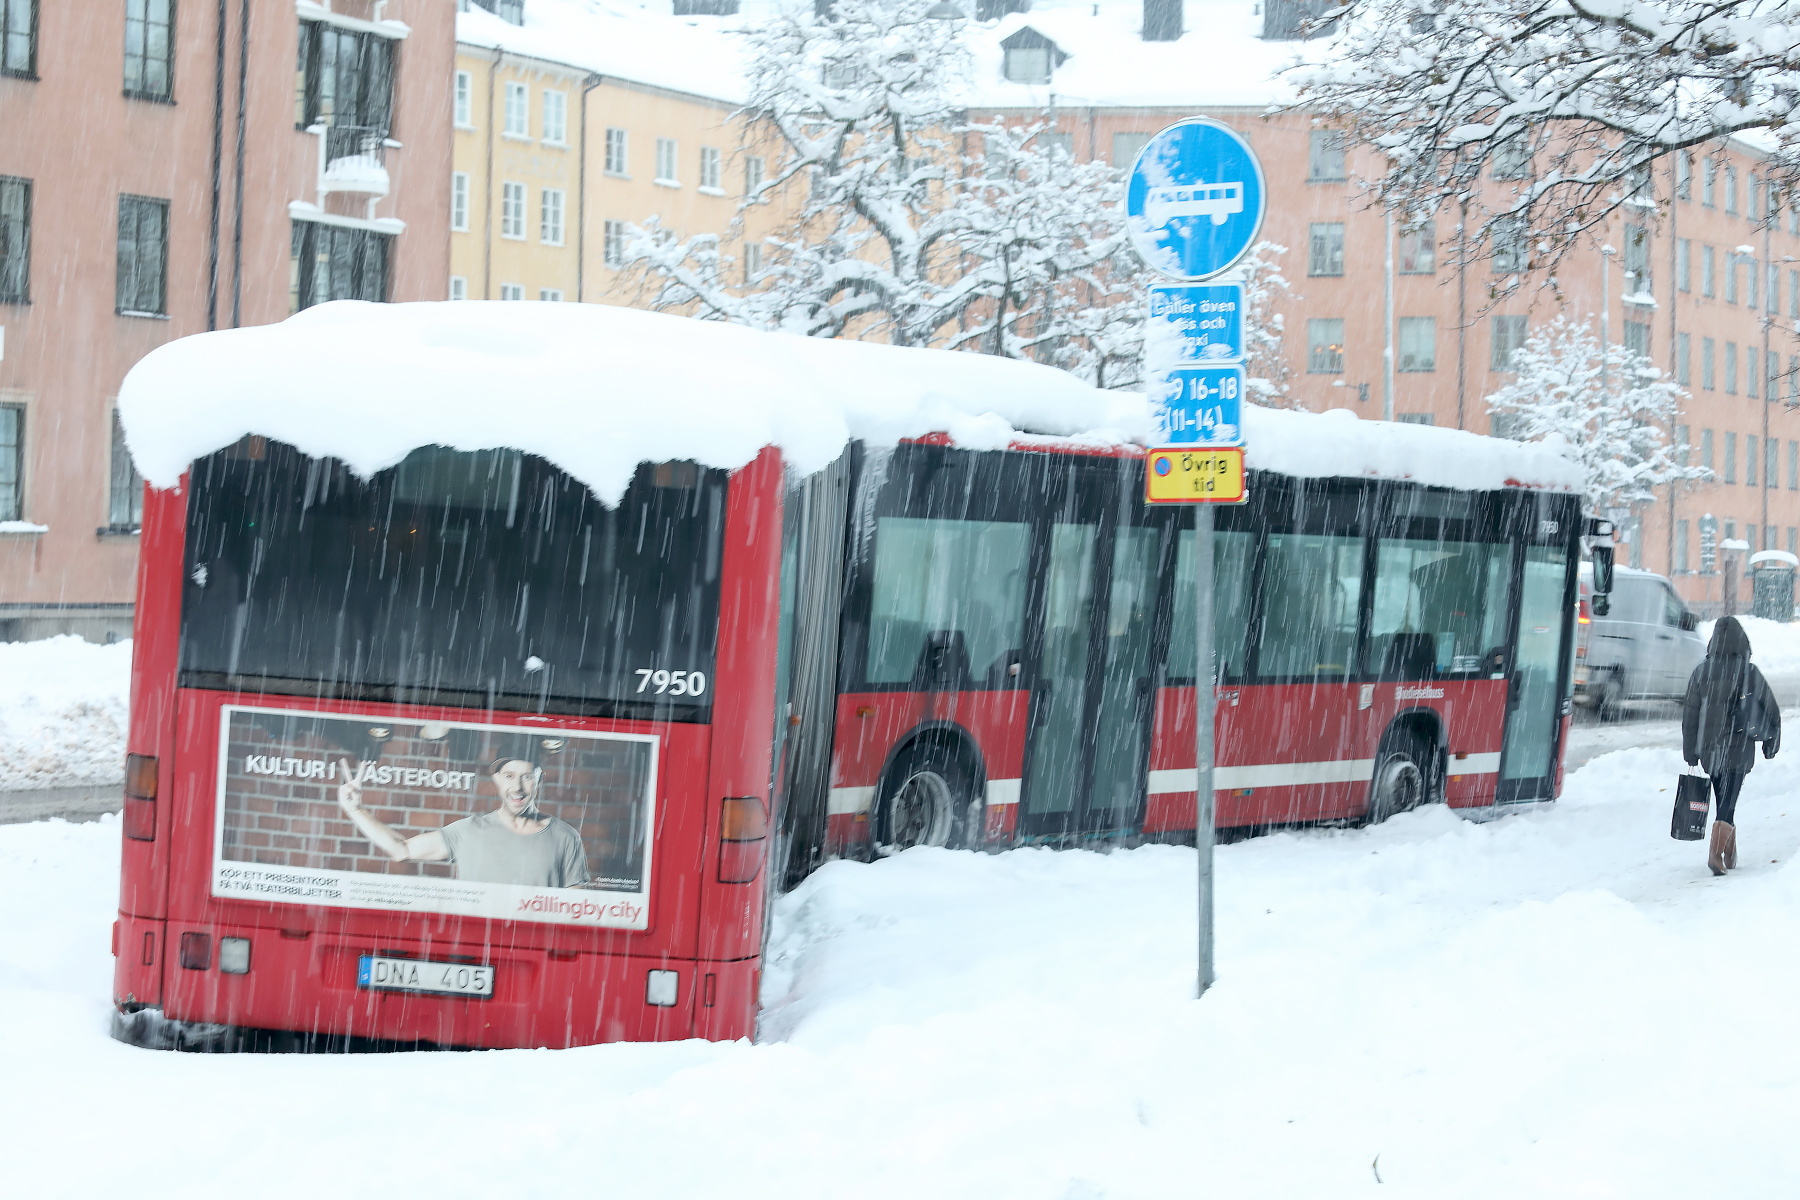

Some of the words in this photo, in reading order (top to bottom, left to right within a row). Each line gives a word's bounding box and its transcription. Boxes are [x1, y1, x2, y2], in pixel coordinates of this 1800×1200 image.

[1155, 298, 1196, 315] Gäller
[1200, 300, 1236, 313] även
[1199, 316, 1226, 330] och
[1185, 333, 1208, 346] axi
[1189, 376, 1238, 400] 16-18
[1164, 405, 1223, 432] (11-14)
[1180, 453, 1228, 474] Övrig
[1193, 477, 1216, 492] tid
[1541, 520, 1558, 534] 7950
[634, 668, 706, 696] 7950
[245, 754, 326, 779] KULTUR
[328, 761, 337, 780] I
[220, 866, 242, 877] KÖP
[244, 870, 262, 881] ETT
[265, 872, 340, 887] PRESENTKORT
[219, 878, 231, 890] FÅ
[235, 880, 252, 892] TVÅ
[254, 883, 342, 898] TEATERBILJETTER
[610, 901, 642, 923] city
[375, 960, 420, 986] DNA
[440, 966, 486, 991] 405
